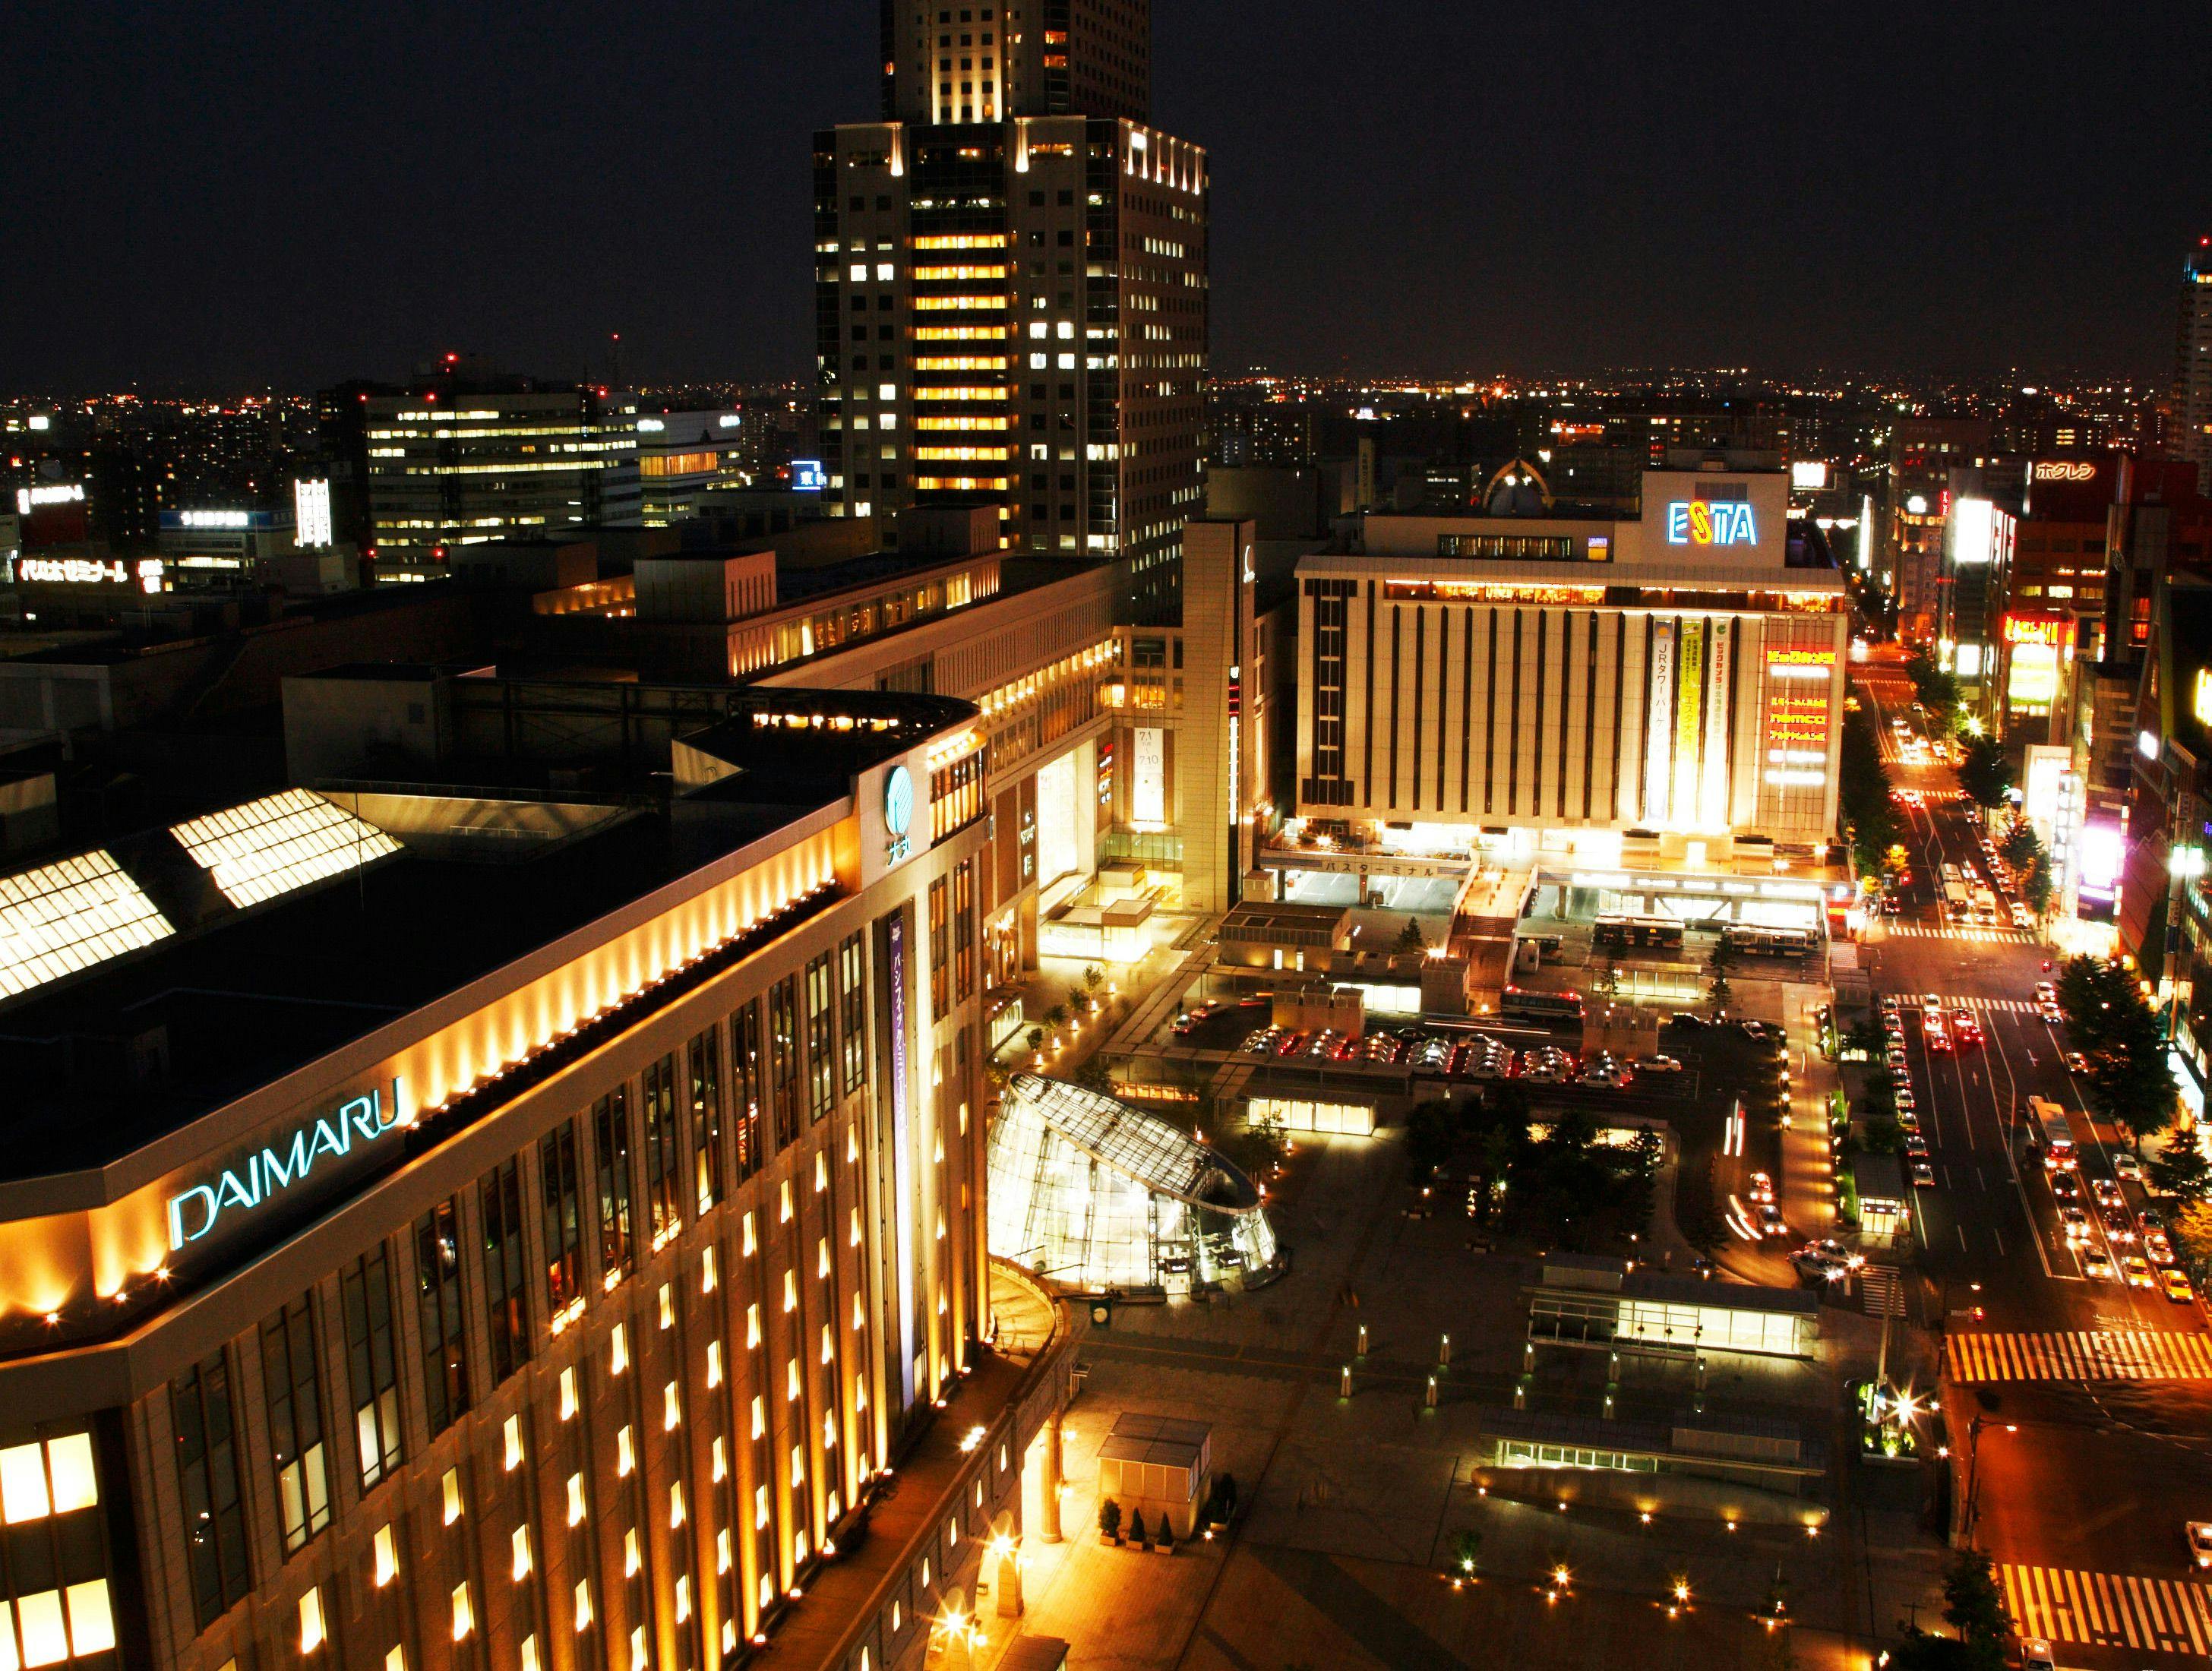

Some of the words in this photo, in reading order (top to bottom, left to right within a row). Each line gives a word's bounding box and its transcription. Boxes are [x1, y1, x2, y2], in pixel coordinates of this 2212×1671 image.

[2036, 463, 2096, 480] ホクレン
[1668, 501, 1756, 545] ESTA
[1769, 712, 1826, 725] namco
[1326, 862, 1433, 877] バスターミナル
[169, 1076, 401, 1250] DAIMARU
